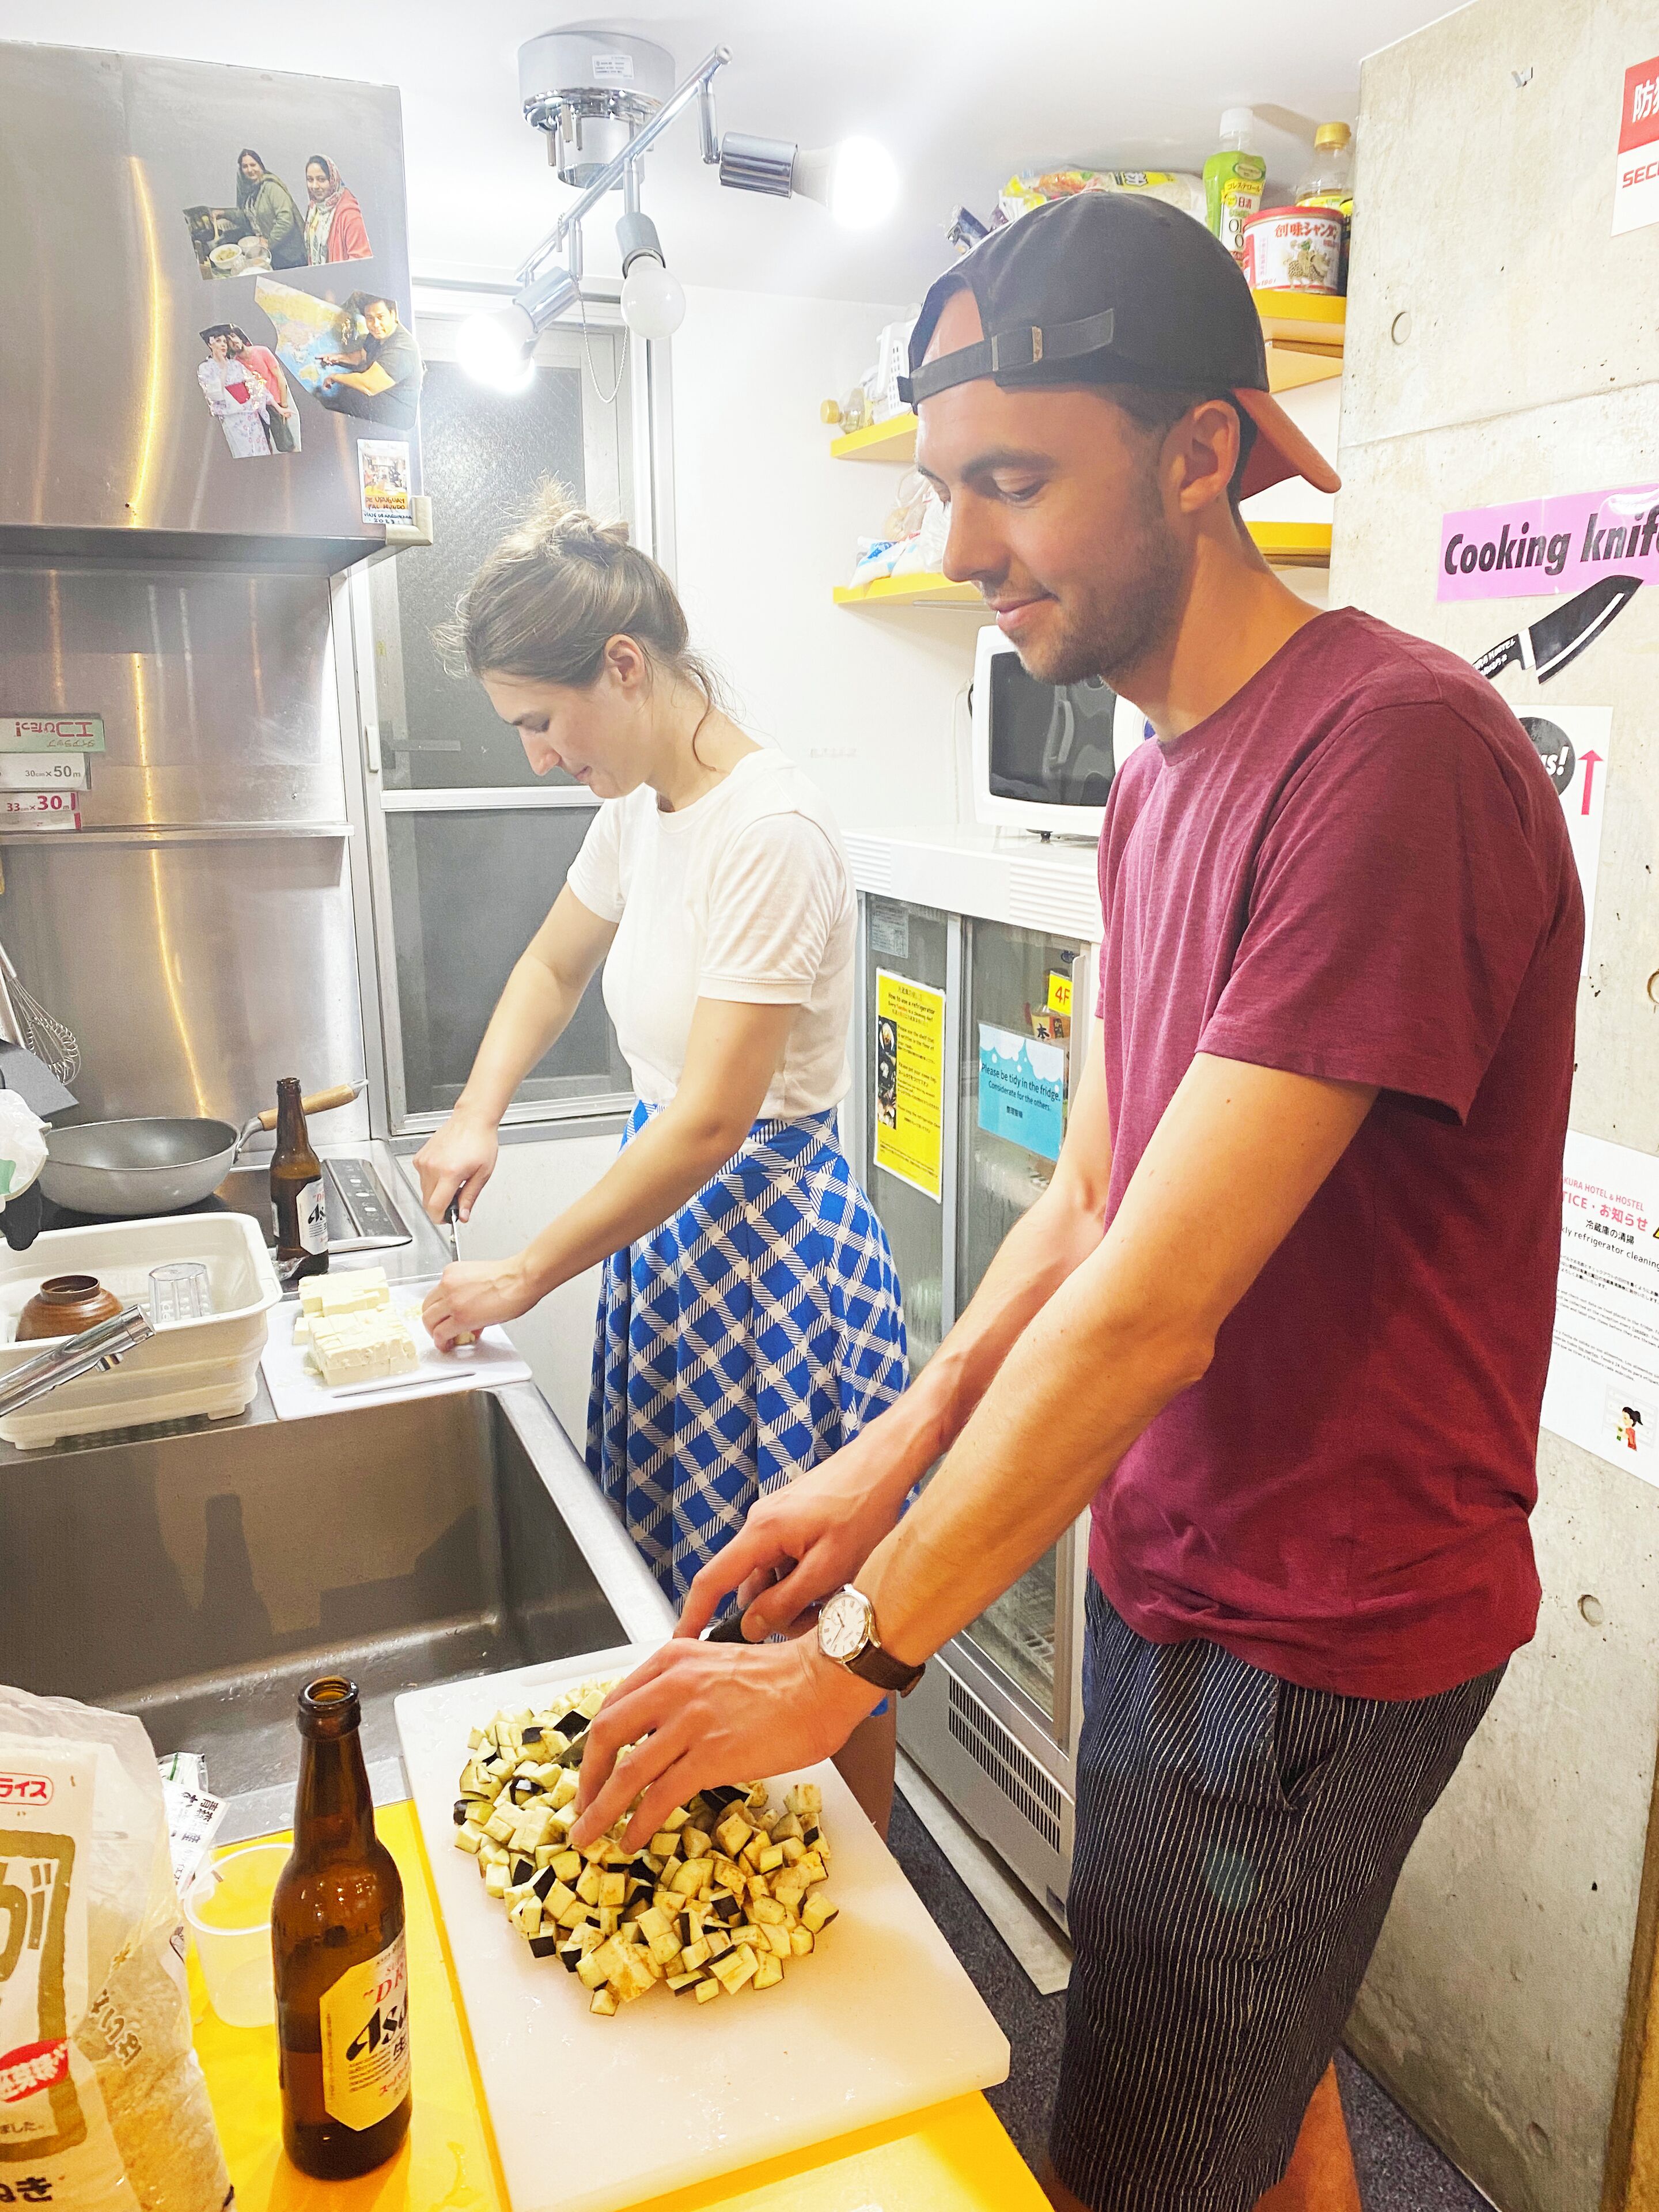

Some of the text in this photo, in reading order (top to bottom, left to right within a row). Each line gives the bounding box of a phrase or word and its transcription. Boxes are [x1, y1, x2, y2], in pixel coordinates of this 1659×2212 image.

[1623, 161, 1659, 188] SEC
[1444, 521, 1571, 575] Cooking
[1055, 986, 1070, 1005] 4F
[982, 1063, 1060, 1102] Please be tidy in the fridge.
[988, 1080, 1016, 1098] Considerate
[1025, 1094, 1033, 1104] the
[1585, 1184, 1607, 1199] HOTEL
[1616, 1195, 1644, 1211] HOSTEL
[1574, 1231, 1624, 1255] refrigerator
[1585, 1219, 1634, 1245] 冷蔵庫の清掃
[0, 1778, 47, 1799] ライス
